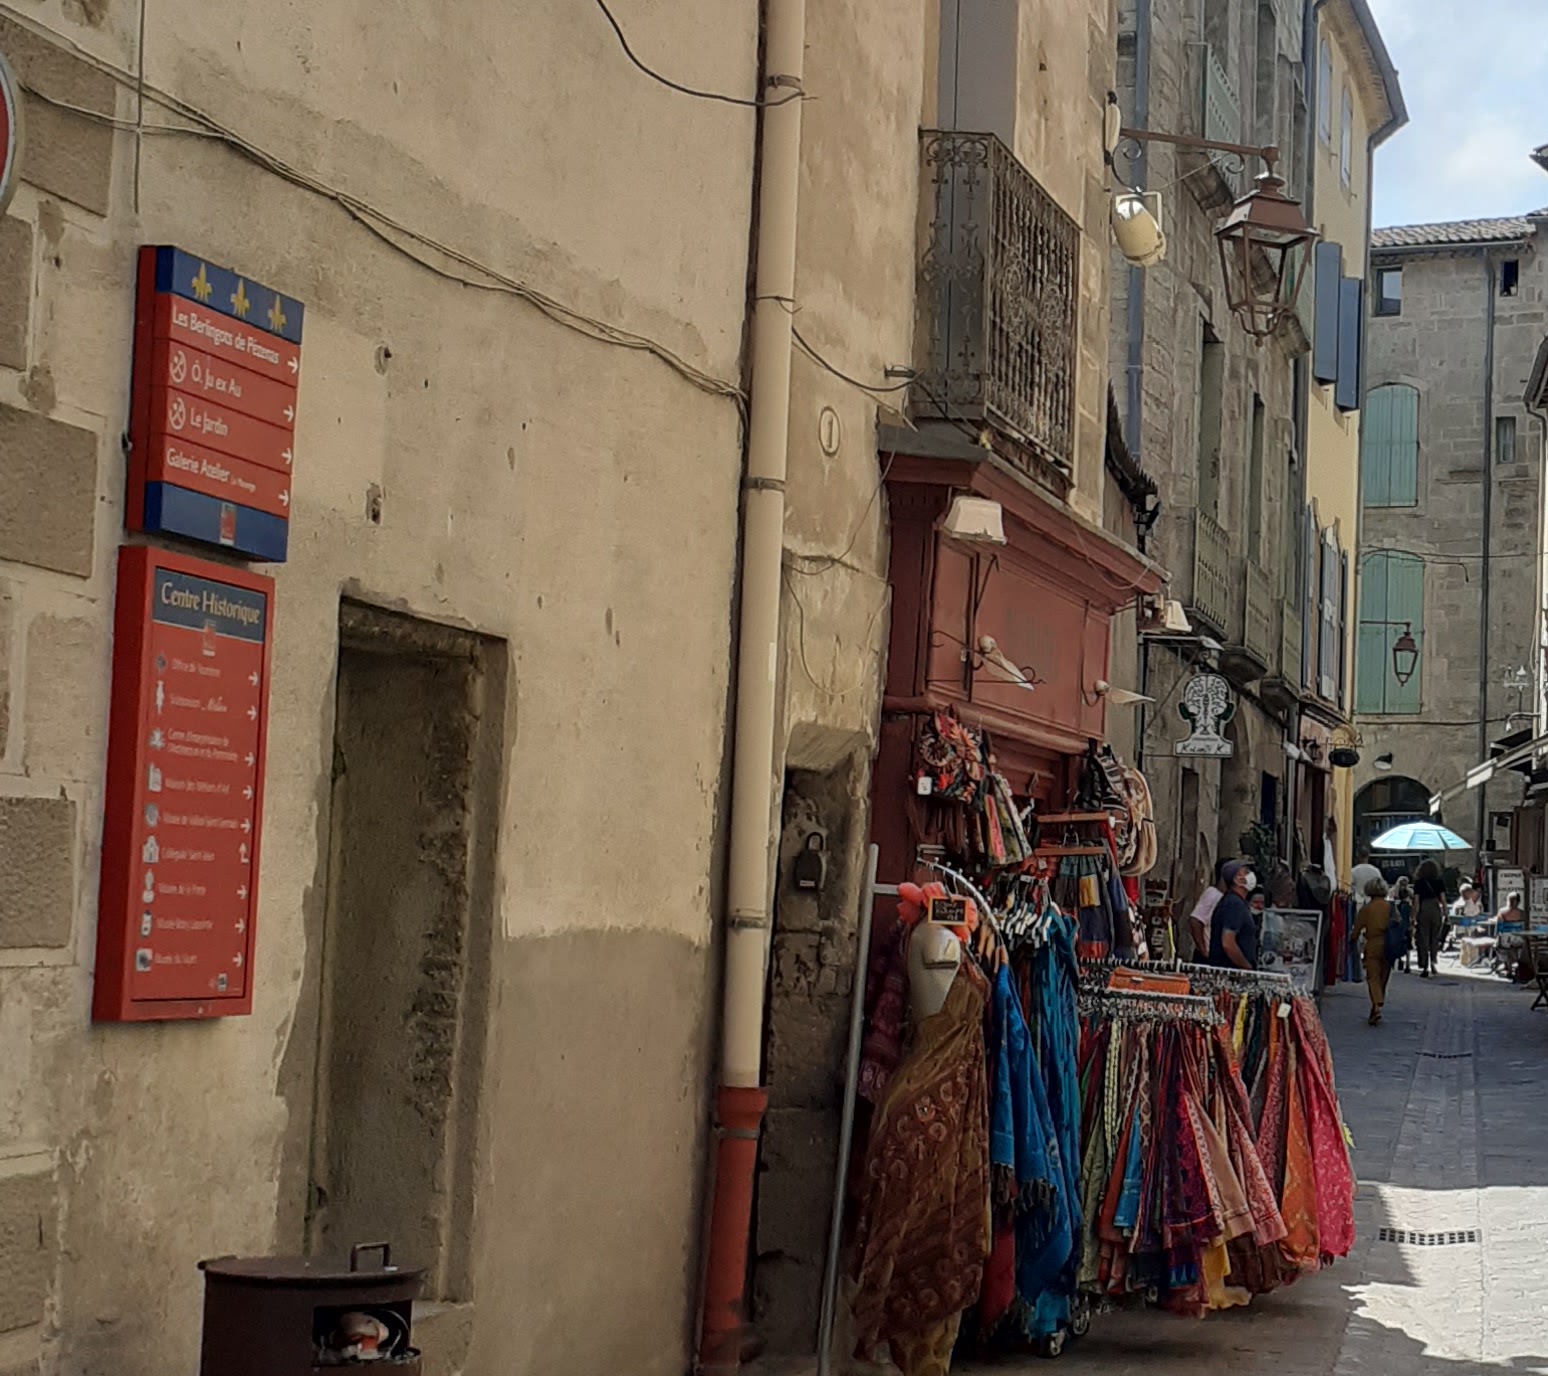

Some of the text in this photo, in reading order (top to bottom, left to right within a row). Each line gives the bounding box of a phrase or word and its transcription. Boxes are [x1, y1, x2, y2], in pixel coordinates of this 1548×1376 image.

[172, 303, 188, 327] Les
[190, 312, 233, 346] Berlingots
[234, 333, 246, 351] de
[215, 376, 226, 391] ex
[227, 378, 242, 398] Au
[190, 406, 228, 436] Le Jardin
[166, 447, 199, 474] Galerie
[161, 581, 261, 626] Centre Historique
